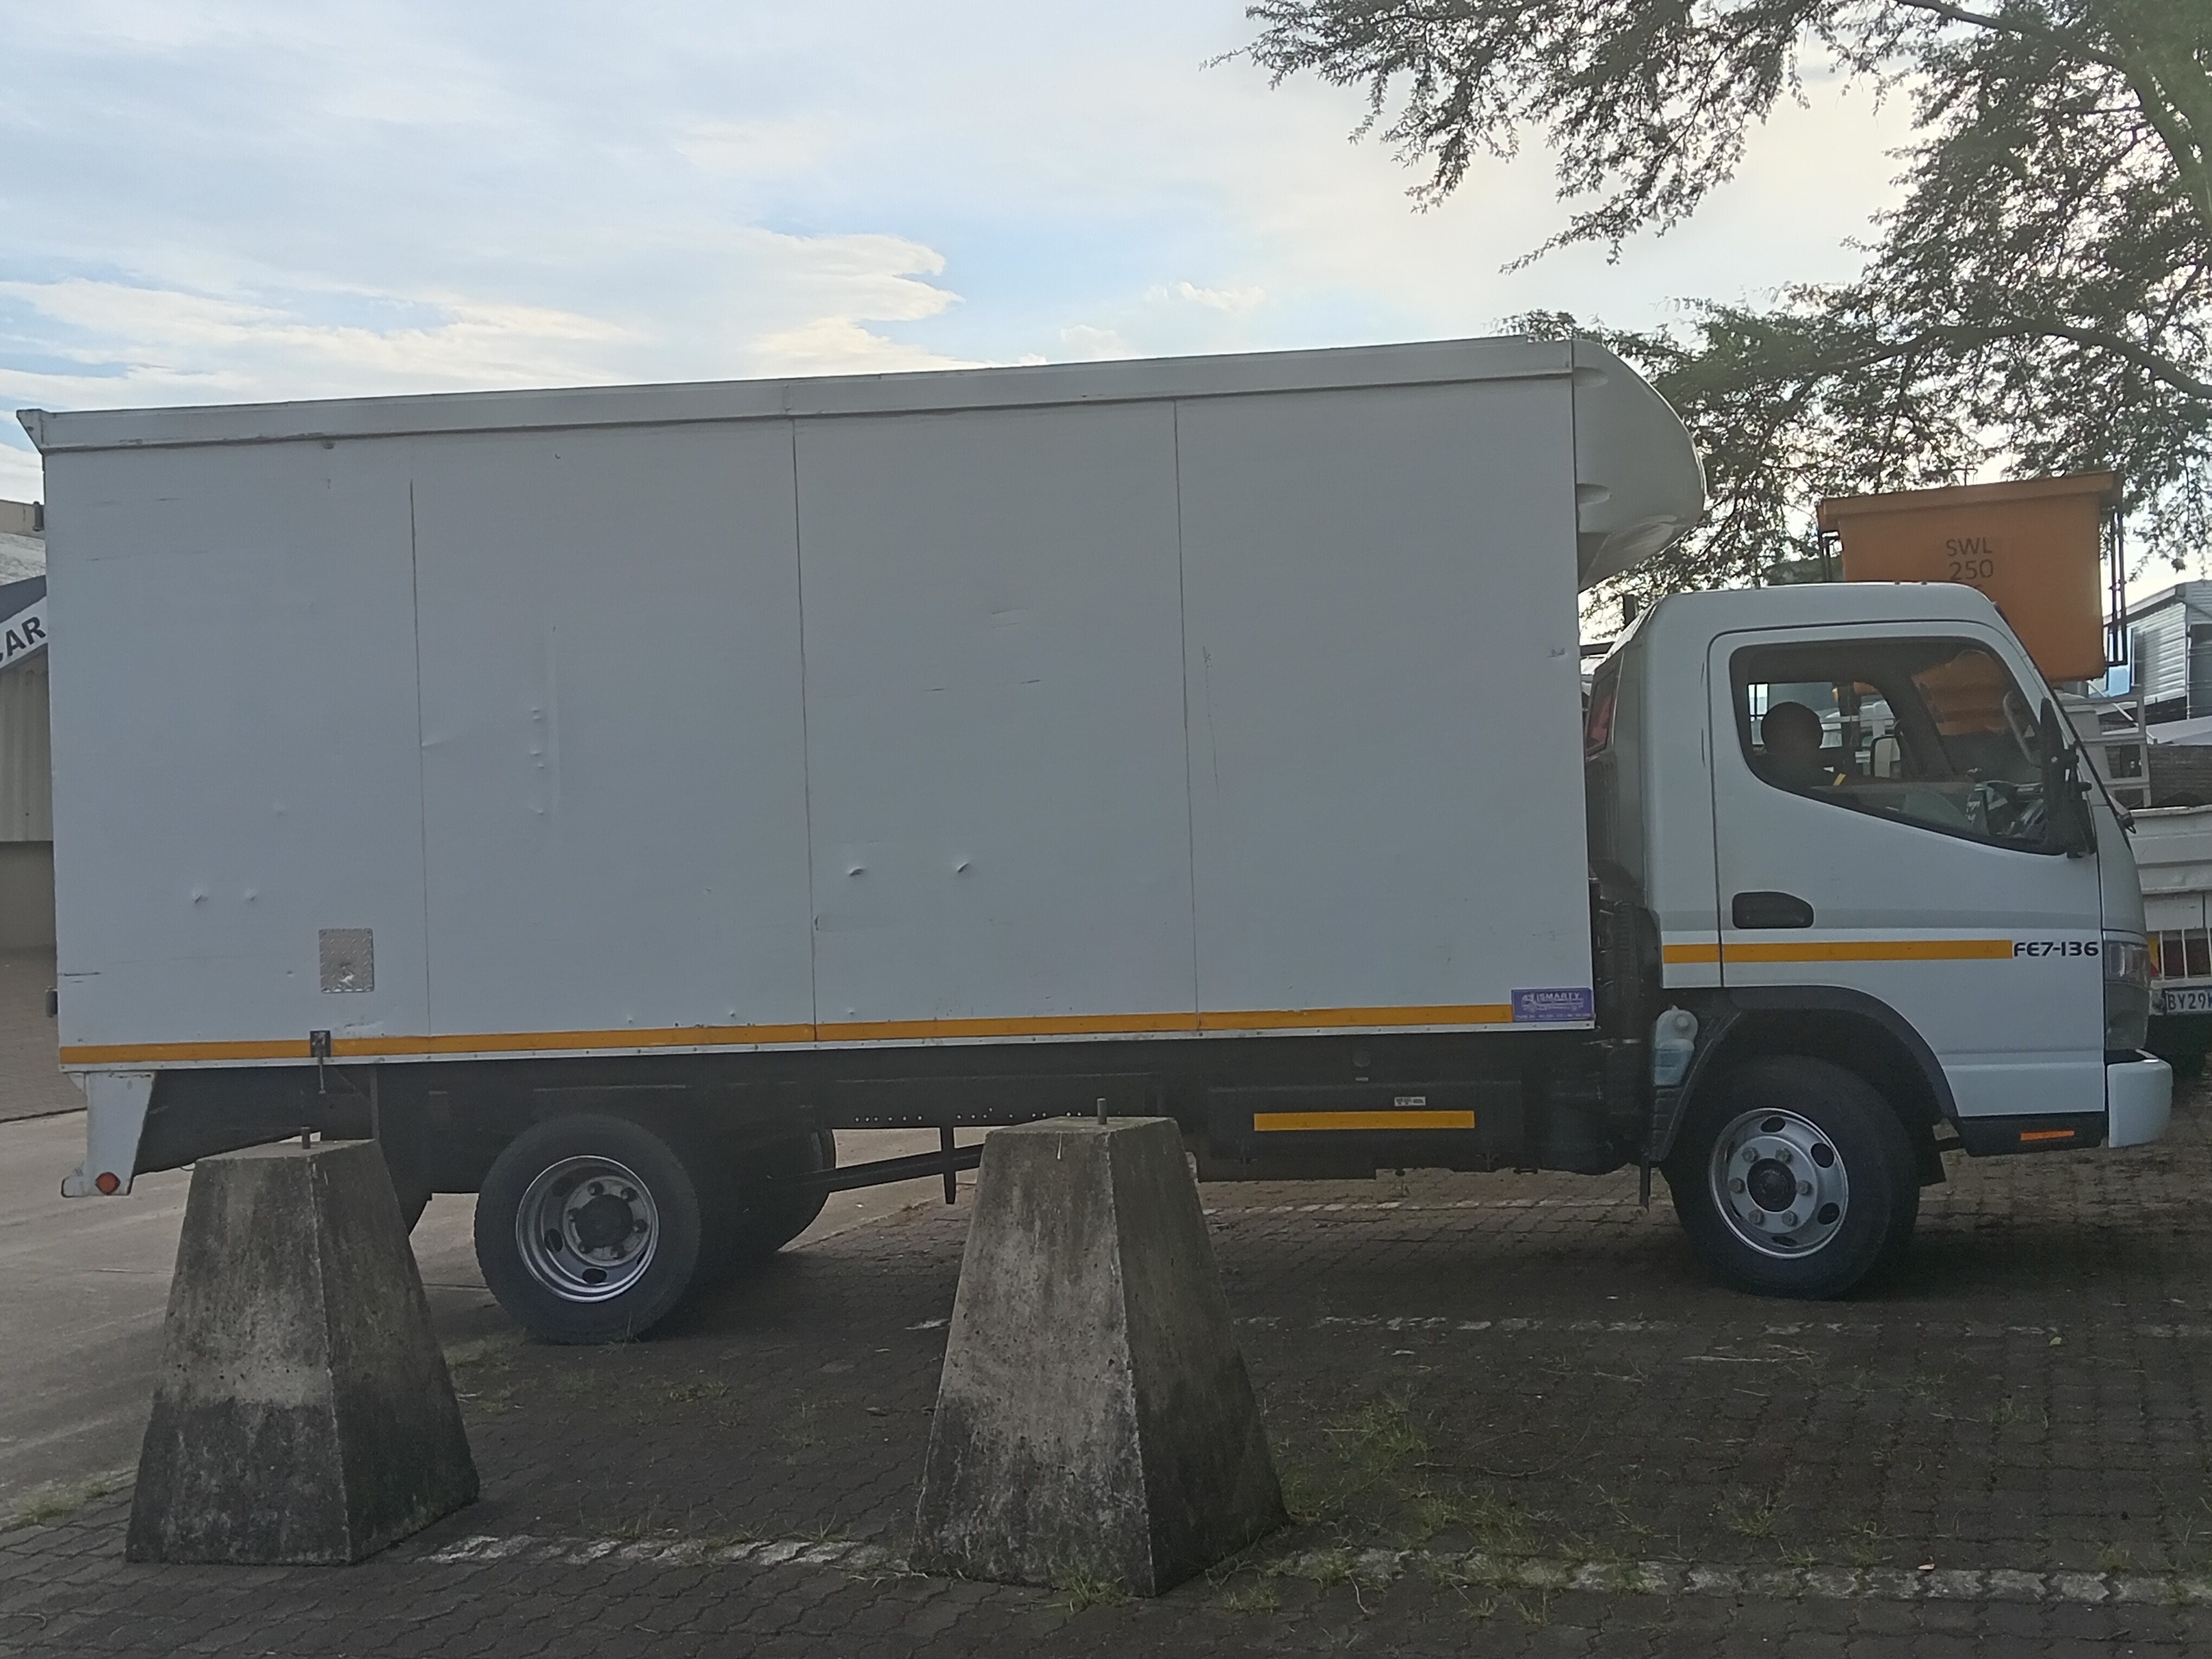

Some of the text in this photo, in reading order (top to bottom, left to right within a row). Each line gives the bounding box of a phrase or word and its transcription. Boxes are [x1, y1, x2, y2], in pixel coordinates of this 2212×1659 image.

[1945, 537, 1993, 557] SWL
[1949, 558, 1994, 581] 250
[2014, 941, 2099, 957] FE7-136
